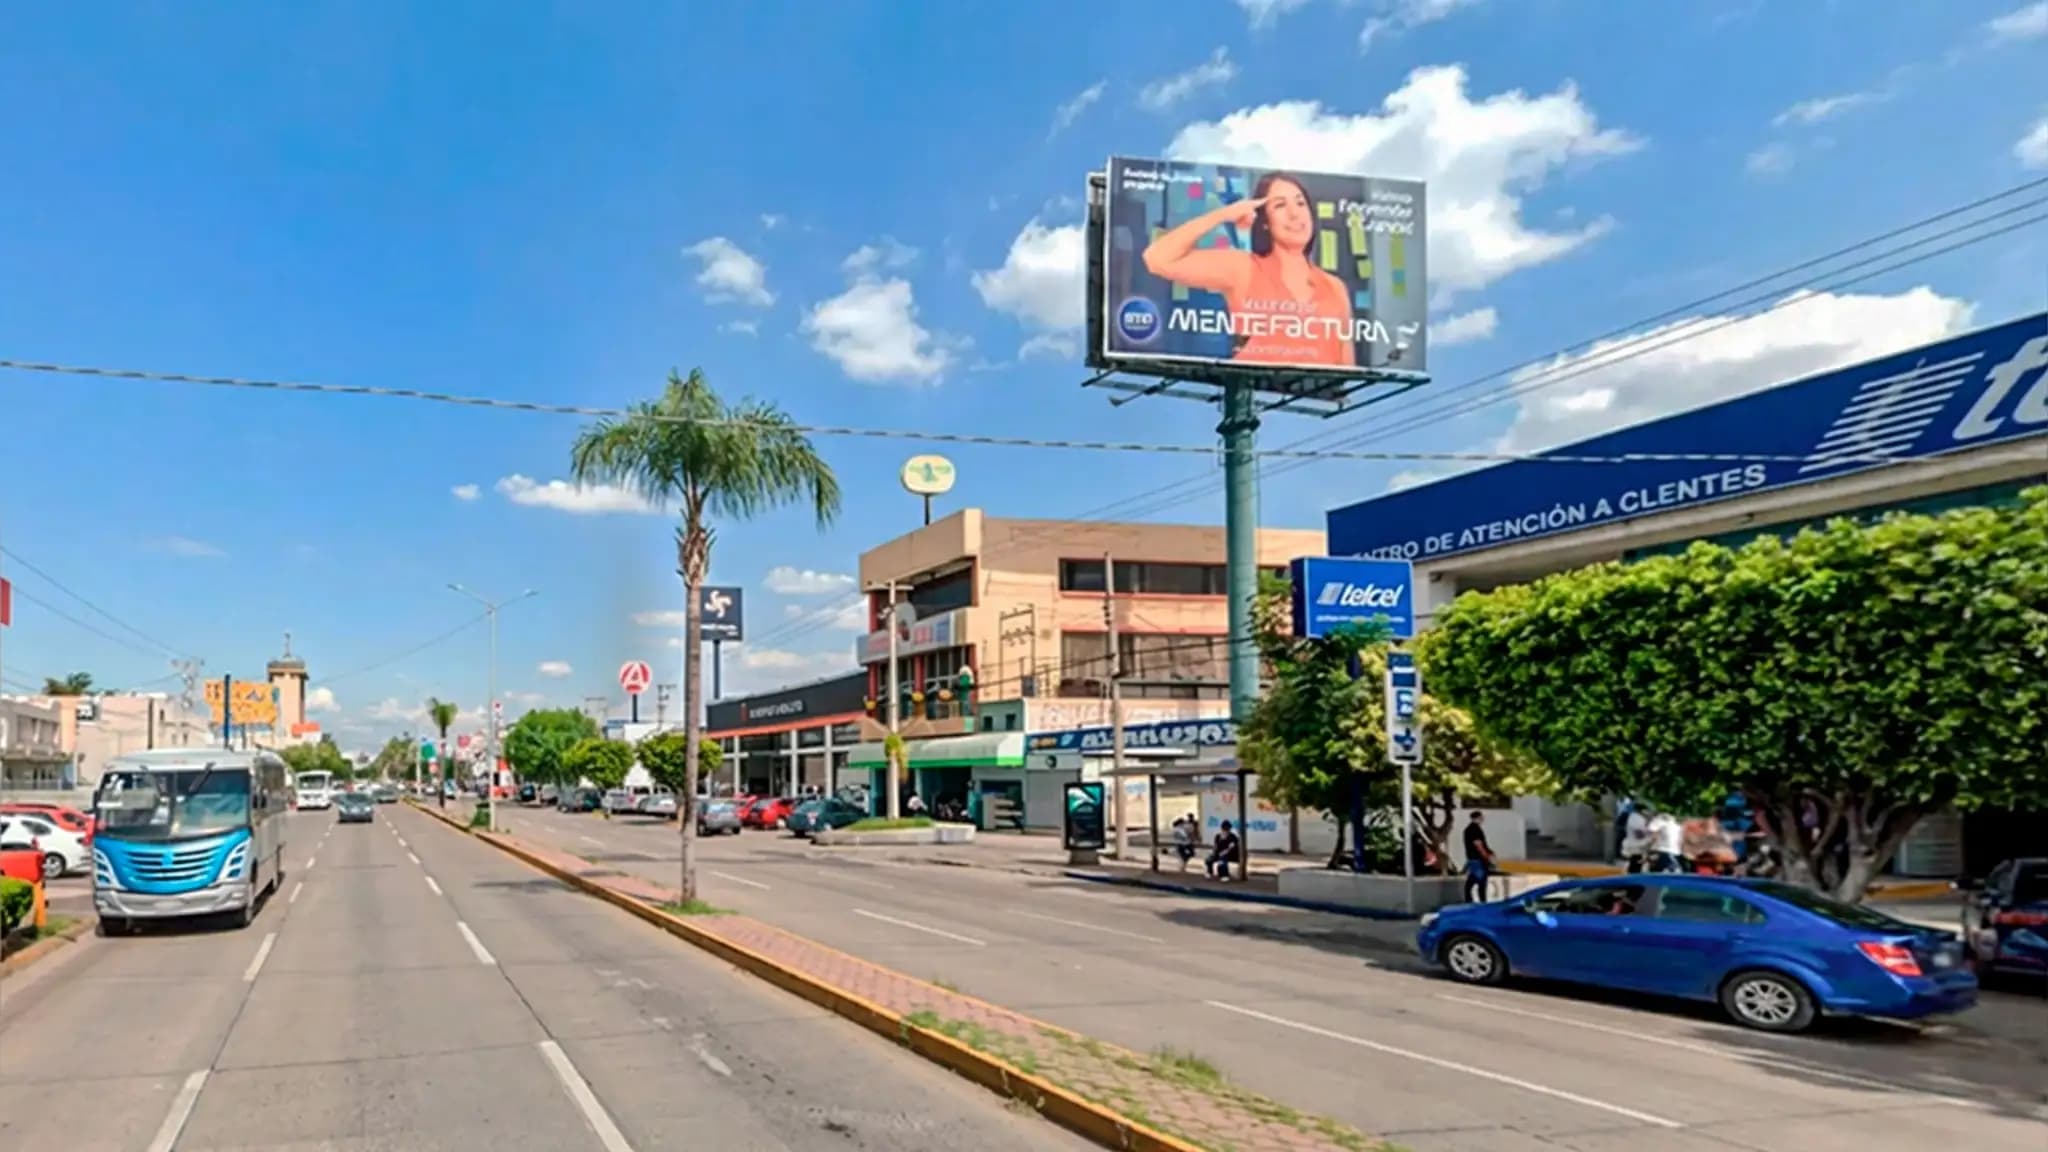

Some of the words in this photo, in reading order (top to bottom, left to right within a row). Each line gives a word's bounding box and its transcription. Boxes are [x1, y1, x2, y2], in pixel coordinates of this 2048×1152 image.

[1425, 532, 1454, 554] DE
[1459, 502, 1585, 546] ATENCIÓN
[1592, 497, 1613, 519] A
[1340, 583, 1404, 608] telcel
